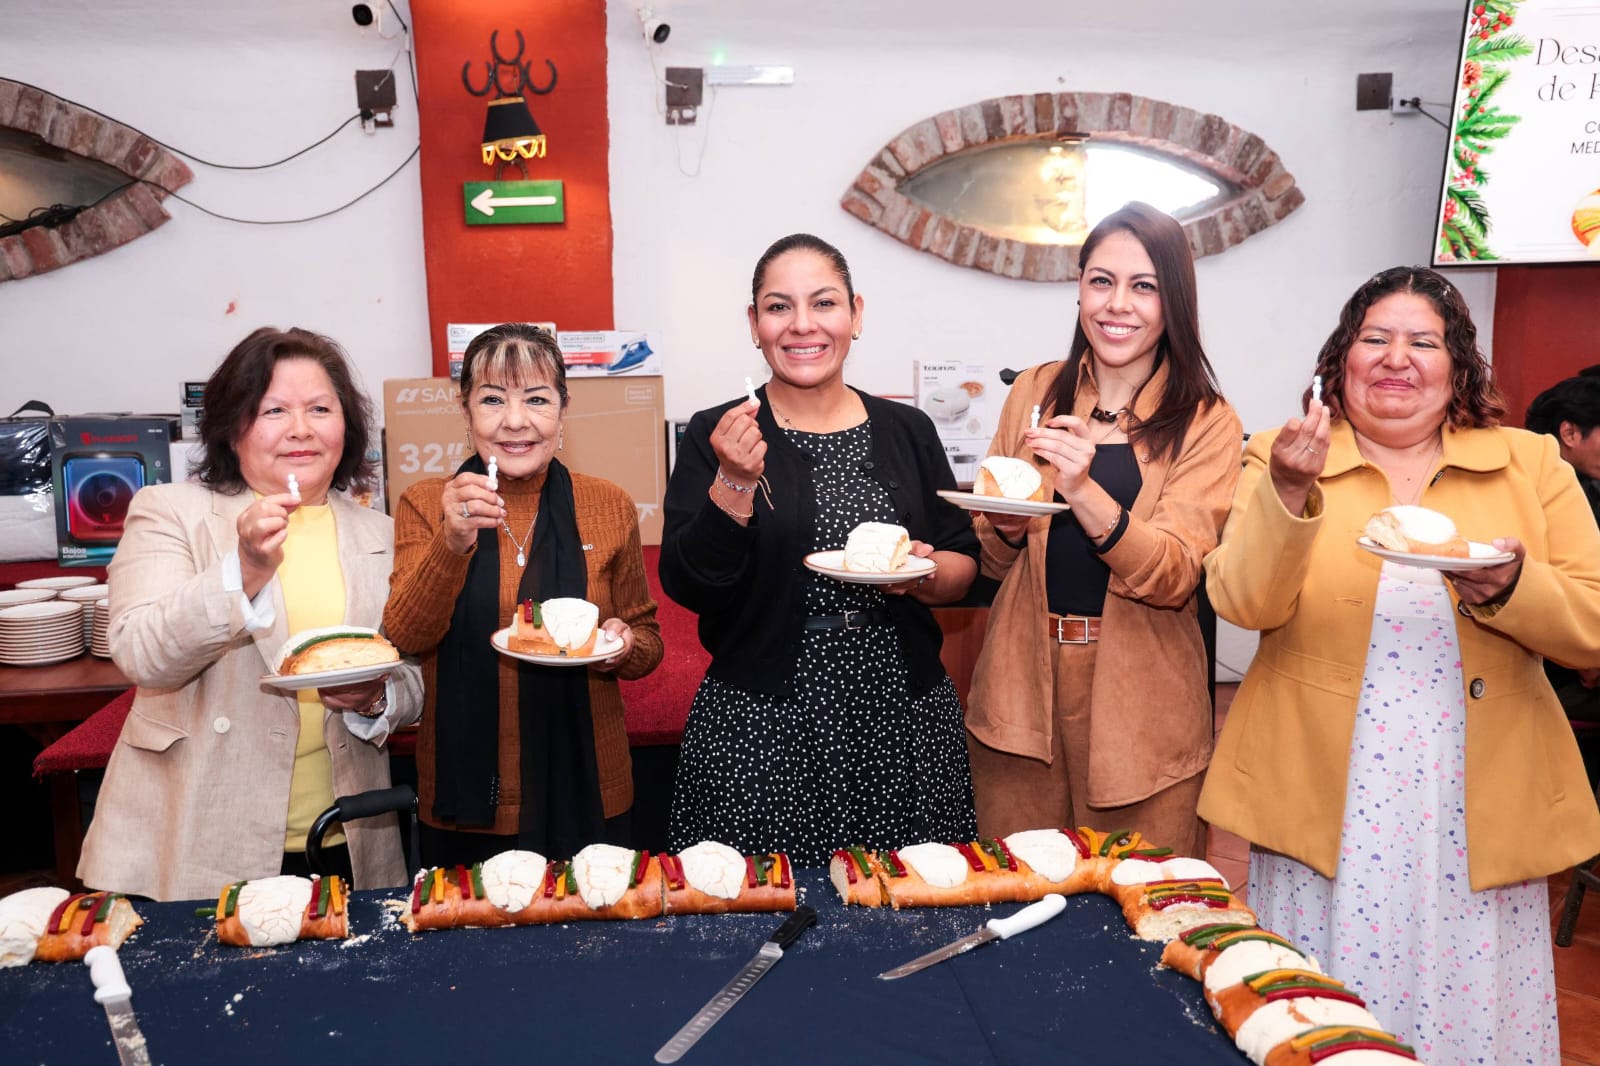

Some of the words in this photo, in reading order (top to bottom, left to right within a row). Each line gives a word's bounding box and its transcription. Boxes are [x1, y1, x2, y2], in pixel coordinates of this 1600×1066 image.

[1536, 38, 1600, 65] Des
[1538, 75, 1577, 101] de
[1585, 121, 1600, 134] C
[63, 546, 87, 556] Bajos
